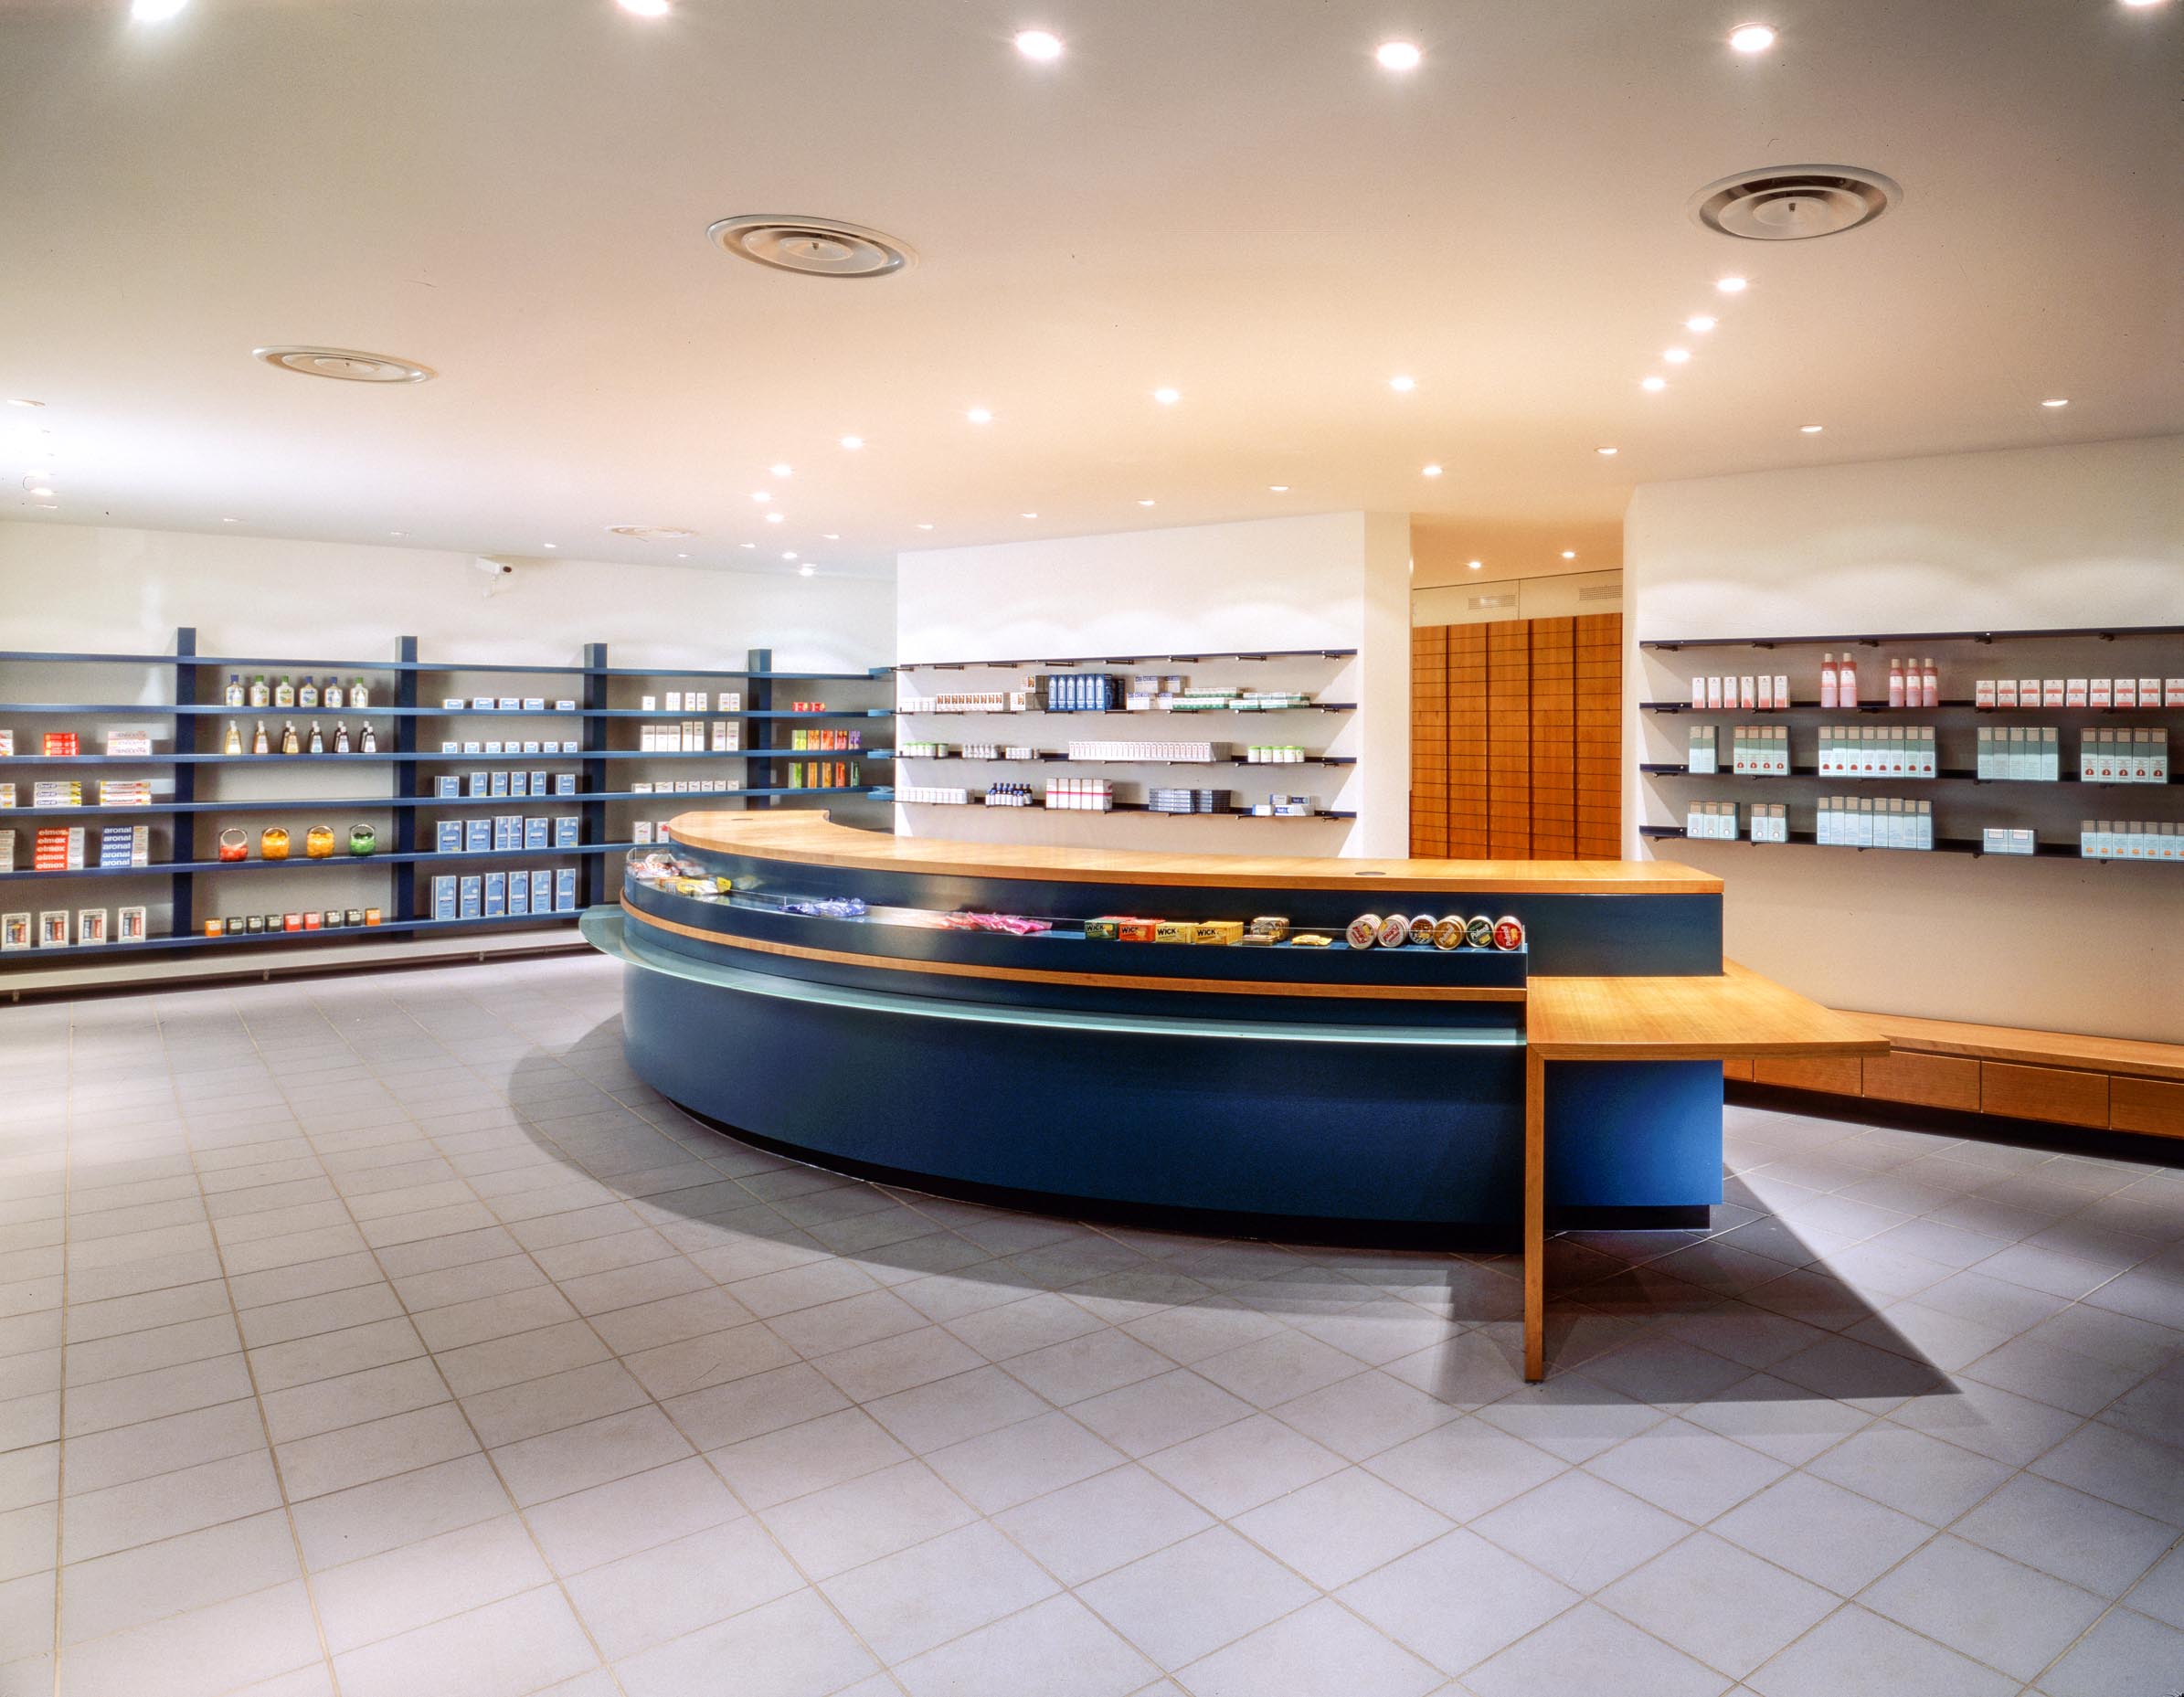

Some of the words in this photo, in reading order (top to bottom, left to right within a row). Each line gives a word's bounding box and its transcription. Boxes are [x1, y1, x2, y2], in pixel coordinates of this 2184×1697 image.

[101, 859, 130, 867] aronal
[1157, 928, 1177, 936] WICK
[1197, 928, 1216, 937] WICK
